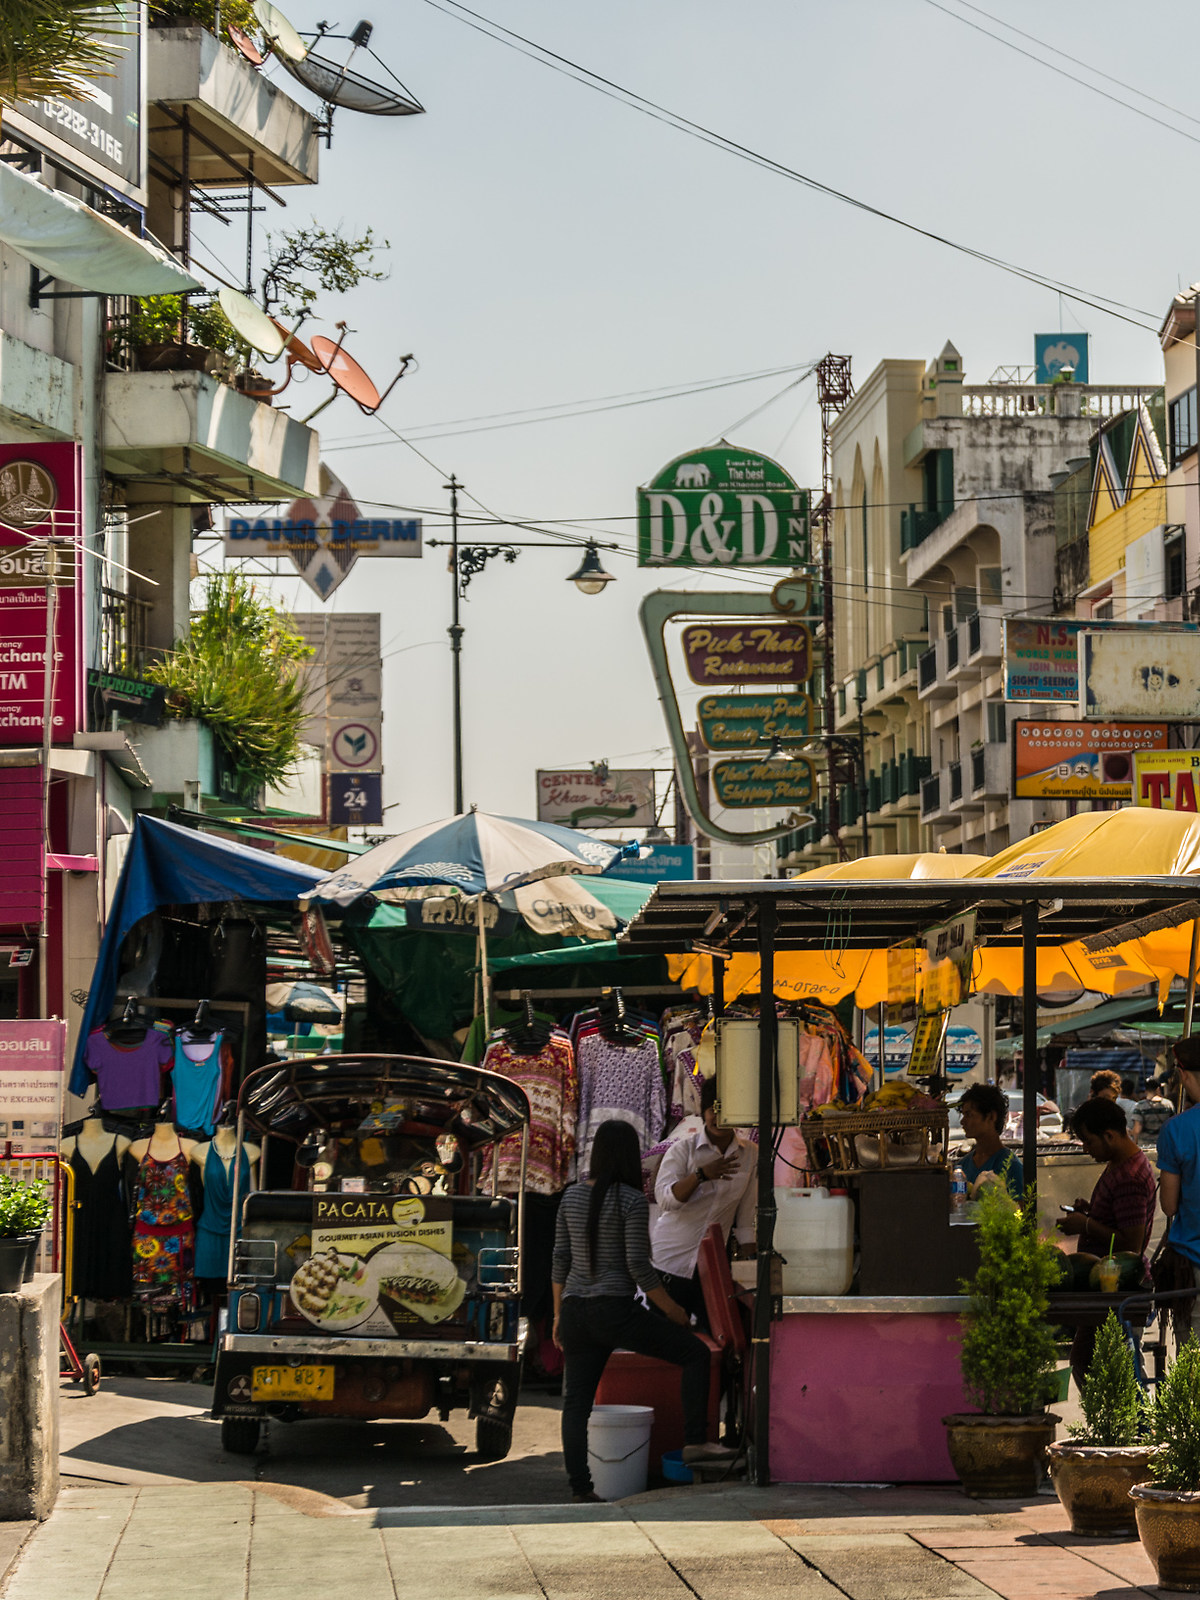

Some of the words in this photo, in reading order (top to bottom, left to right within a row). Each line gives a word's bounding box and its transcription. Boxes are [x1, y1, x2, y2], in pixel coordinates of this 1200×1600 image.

[728, 468, 744, 480] The
[746, 467, 765, 480] best
[332, 518, 417, 541] DERM
[645, 492, 779, 564] D&D
[688, 628, 804, 654] Pick-Thai
[704, 656, 794, 676] Restaurant
[702, 702, 773, 721] Swimming
[773, 699, 806, 716] Pool
[1020, 727, 1084, 738] NIPPON
[343, 791, 367, 807] 24
[543, 789, 590, 806] Khao
[318, 1201, 389, 1217] PACATA
[318, 1234, 357, 1242] GOURMET
[387, 1230, 416, 1238] FUSION
